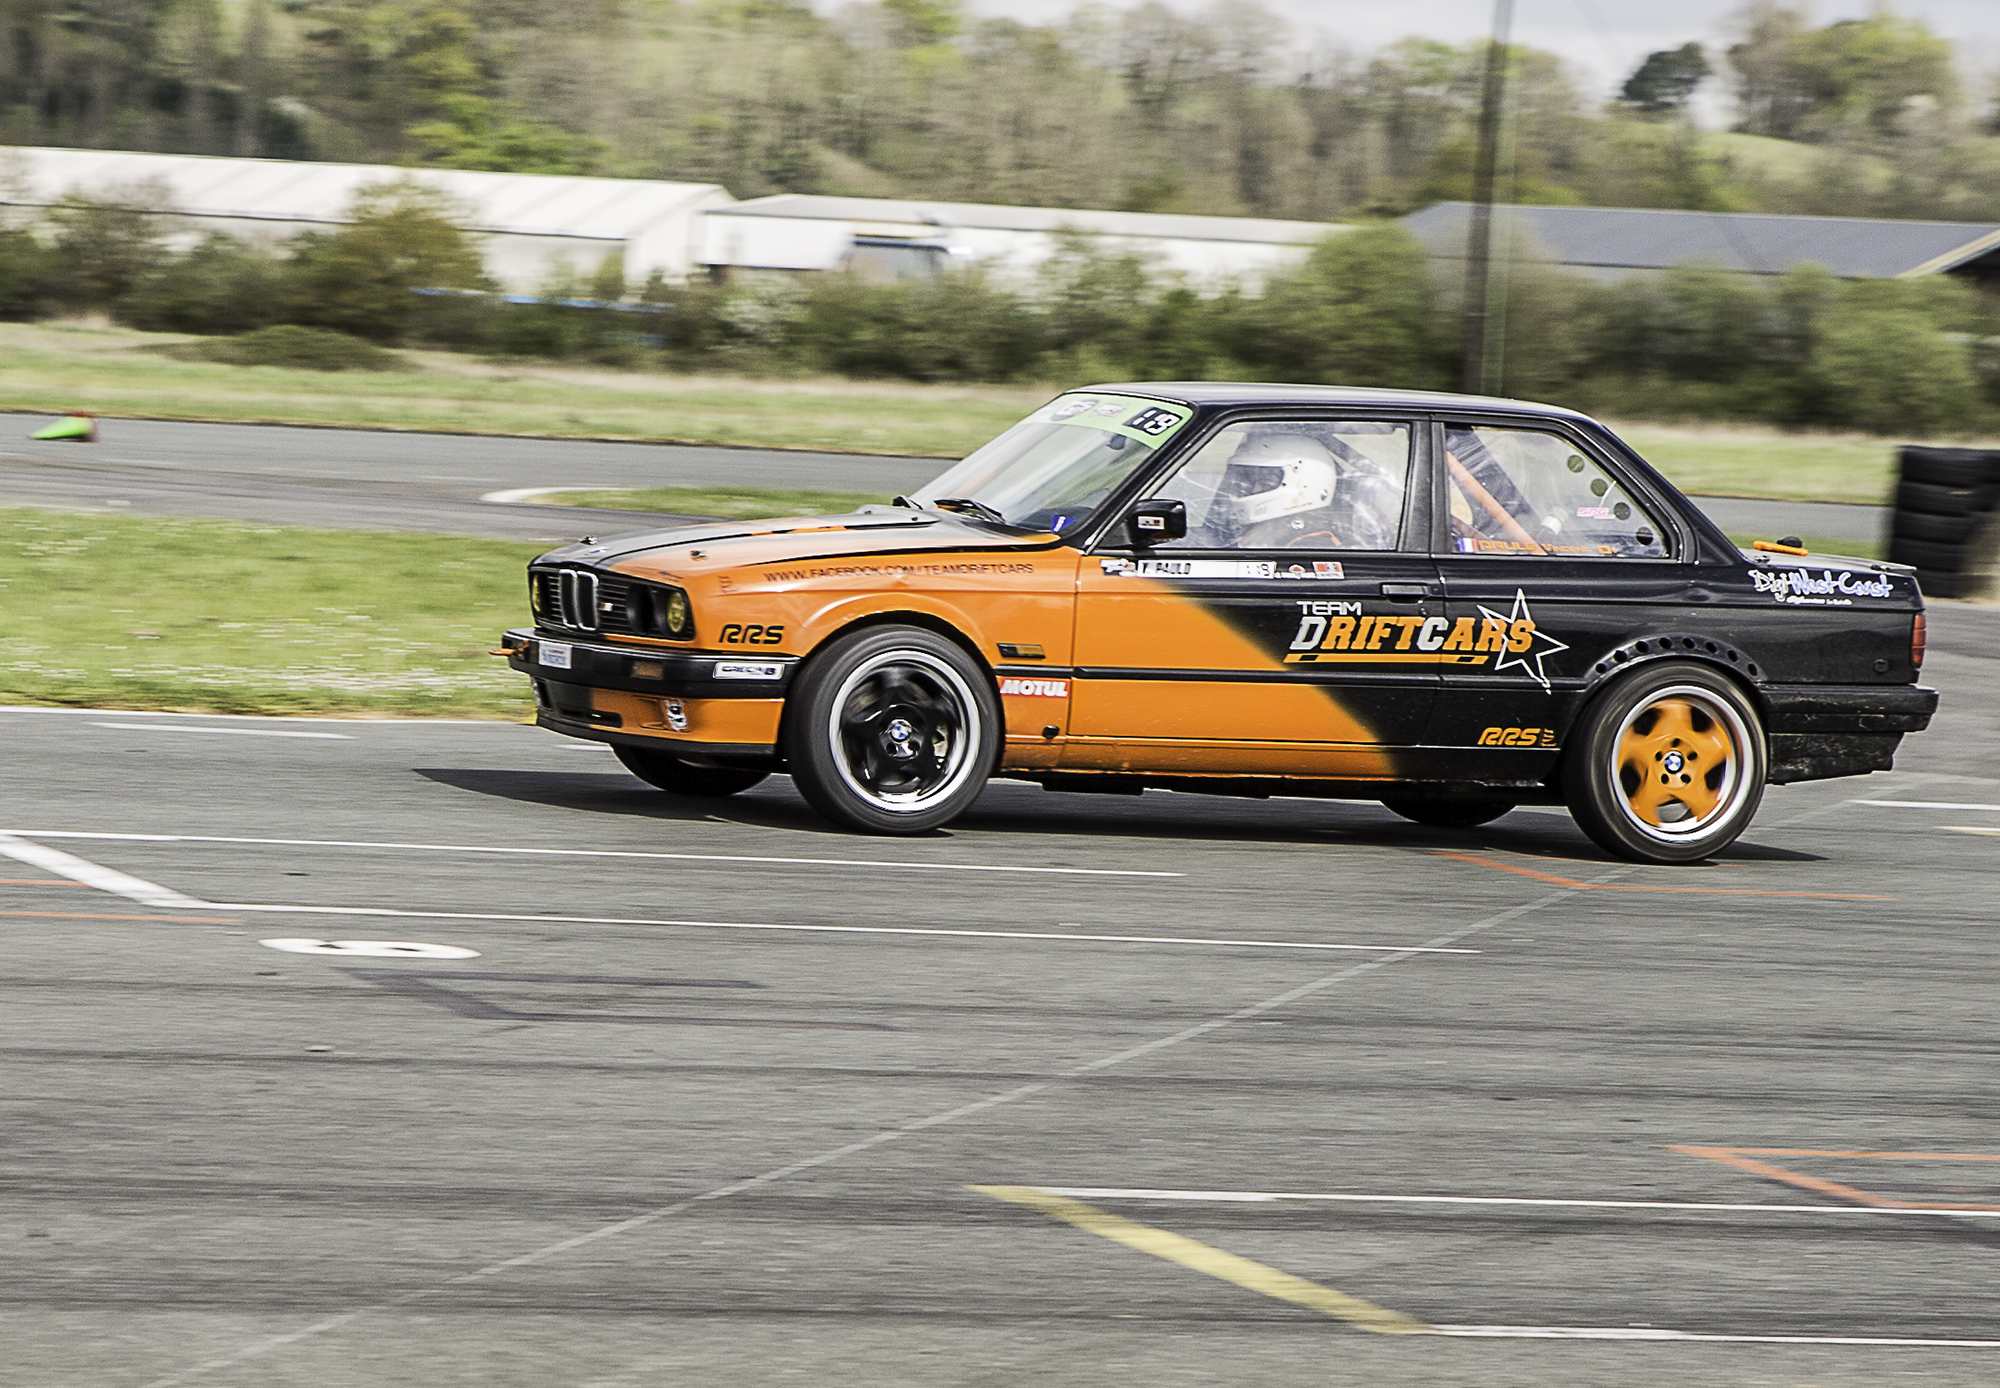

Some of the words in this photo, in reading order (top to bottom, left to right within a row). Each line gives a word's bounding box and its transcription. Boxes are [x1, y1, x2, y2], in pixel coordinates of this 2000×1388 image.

[1295, 601, 1362, 616] TEAM
[718, 624, 785, 645] RRS
[1289, 616, 1537, 653] DRIFTCARS
[999, 680, 1068, 697] MOTUL
[1477, 727, 1541, 746] RRS
